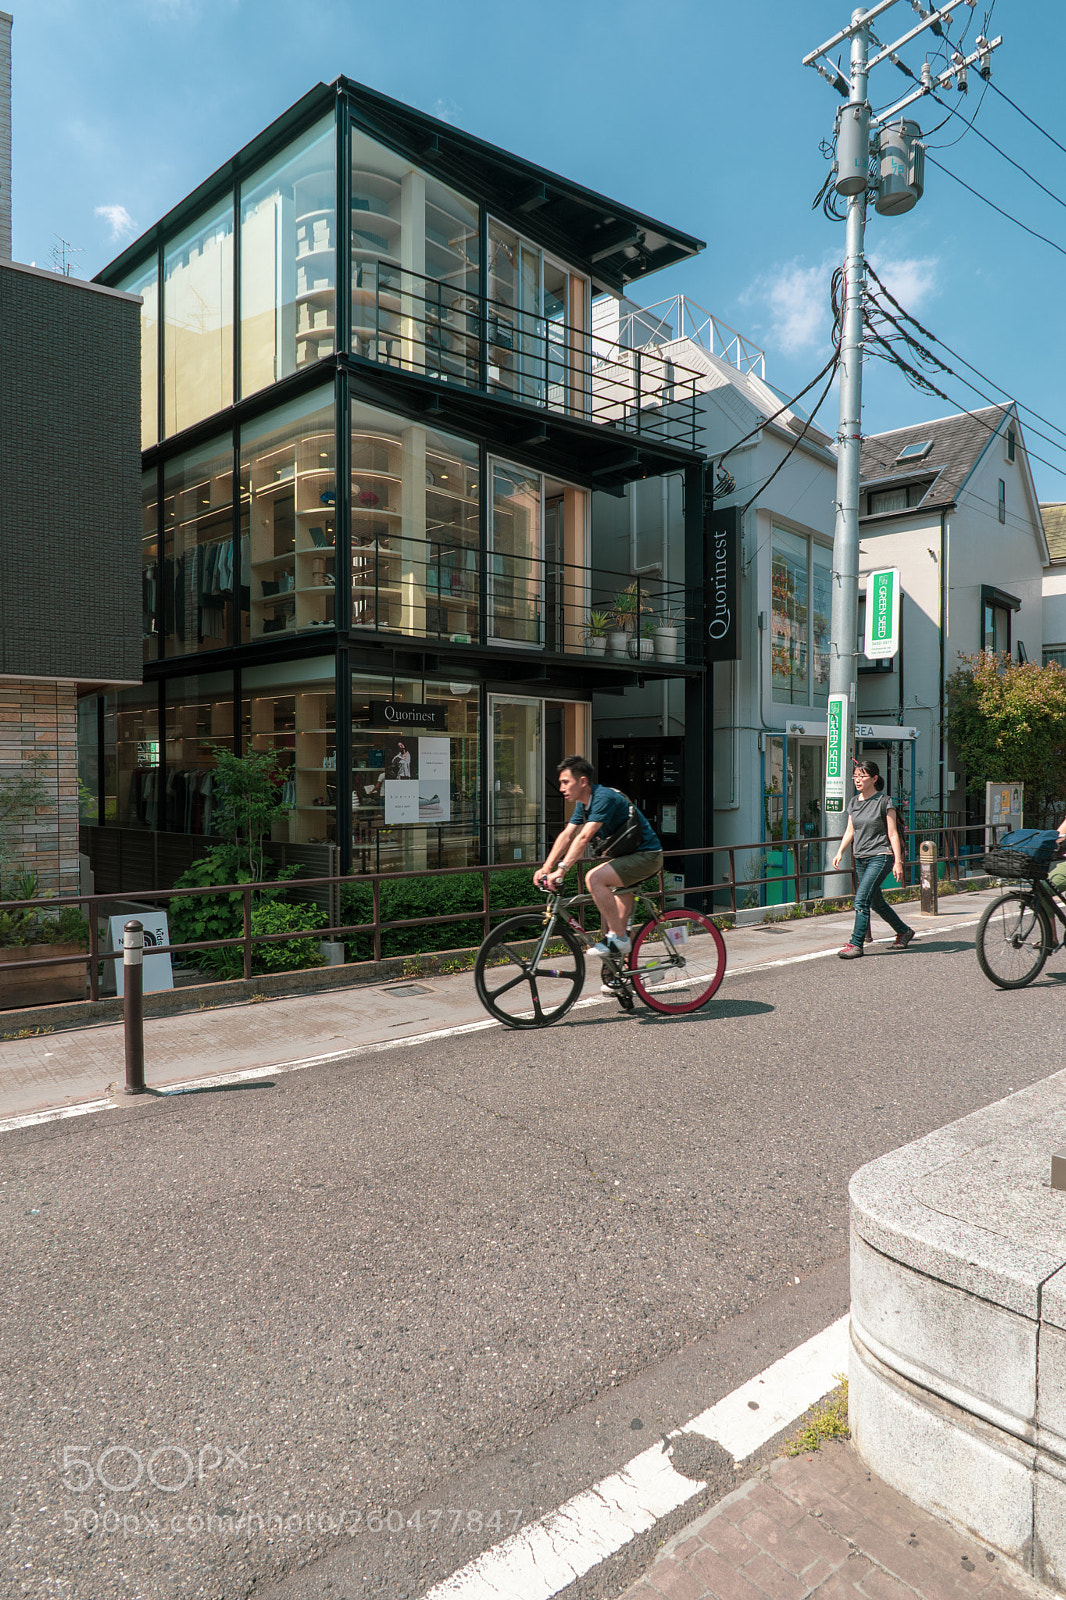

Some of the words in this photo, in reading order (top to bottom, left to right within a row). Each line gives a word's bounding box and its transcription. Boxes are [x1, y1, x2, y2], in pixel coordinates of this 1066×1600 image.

[708, 529, 731, 640] Quorinest
[878, 586, 888, 615] GREEN
[877, 615, 887, 639] SEED
[384, 705, 436, 722] Quorinest
[829, 714, 839, 749] GREEN
[828, 749, 838, 775] SEED
[155, 927, 164, 946] kids
